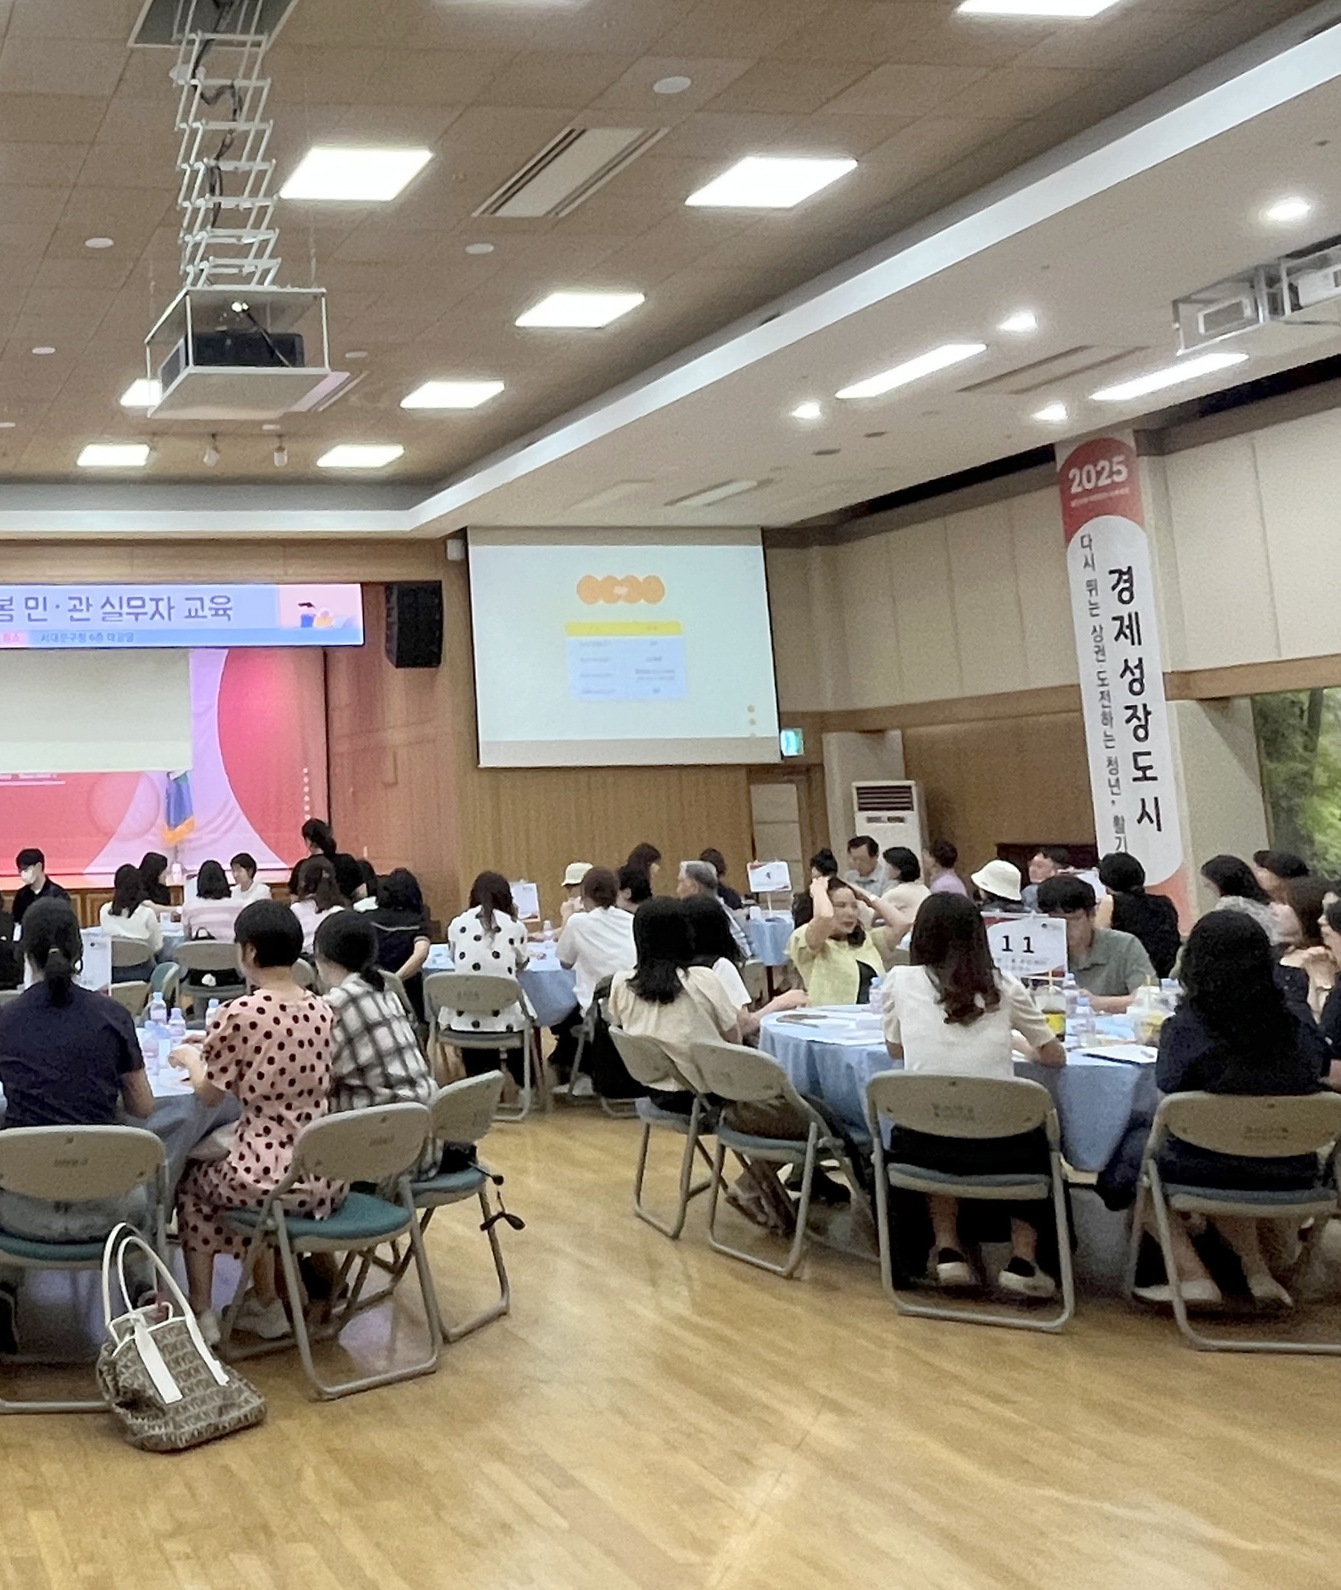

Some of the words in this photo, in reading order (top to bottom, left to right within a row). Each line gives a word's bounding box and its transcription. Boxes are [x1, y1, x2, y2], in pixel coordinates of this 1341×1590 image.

[1068, 454, 1129, 494] 2025
[1079, 533, 1096, 572] 다시
[100, 595, 176, 622] 실무자
[184, 595, 233, 622] 교육
[1108, 565, 1163, 833] 경제성장도시
